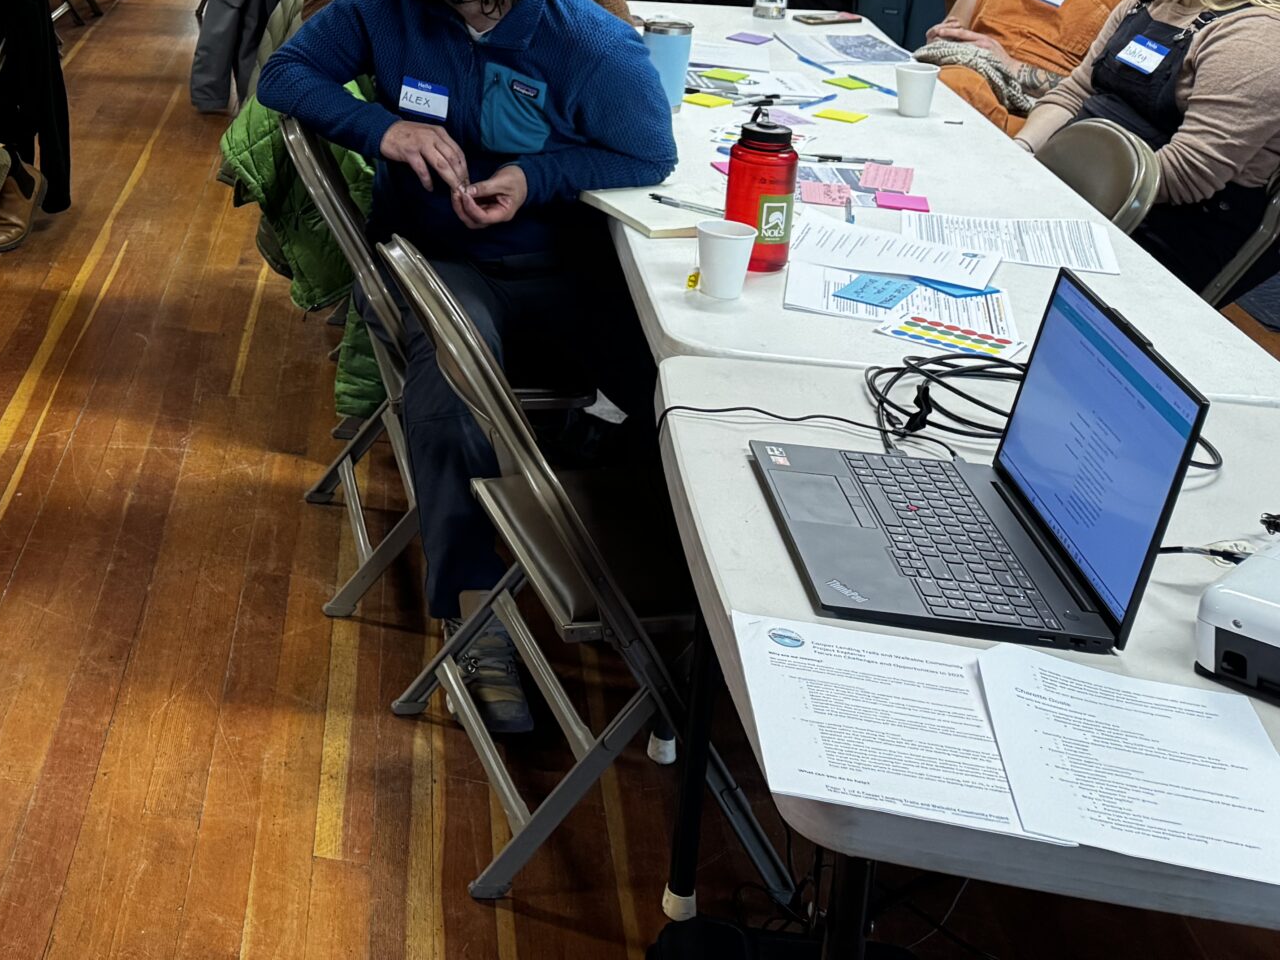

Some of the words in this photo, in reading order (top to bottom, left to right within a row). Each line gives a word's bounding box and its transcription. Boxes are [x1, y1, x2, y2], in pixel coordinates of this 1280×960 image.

[417, 81, 432, 90] Hello
[401, 91, 431, 108] ALEX
[761, 227, 784, 237] NOLS
[826, 579, 869, 604] ThinkPad
[835, 644, 861, 654] Landing
[894, 654, 924, 663] Walkable
[925, 659, 963, 670] Community
[843, 655, 878, 665] Challenges
[893, 663, 938, 675] Opportunities
[1048, 697, 1071, 707] Goals
[957, 809, 988, 818] Community
